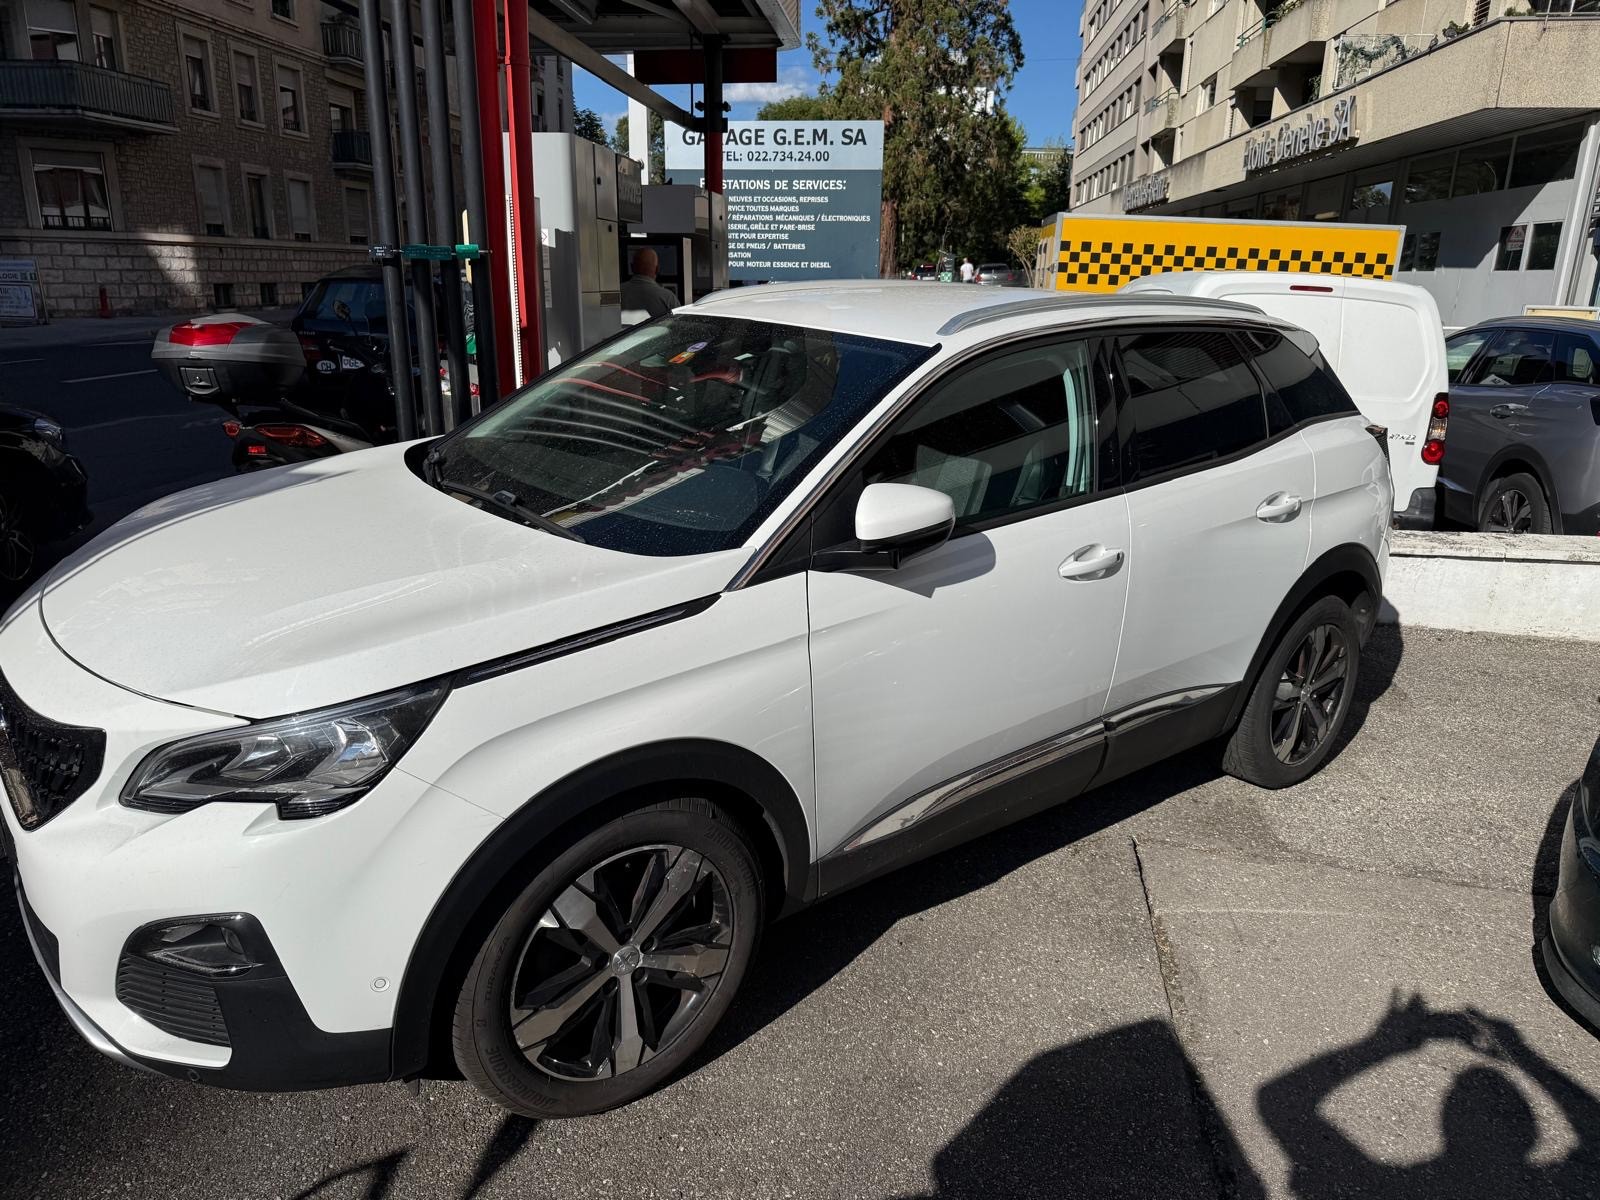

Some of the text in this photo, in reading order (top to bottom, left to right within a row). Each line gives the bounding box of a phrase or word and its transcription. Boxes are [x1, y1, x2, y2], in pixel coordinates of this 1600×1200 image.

[1330, 95, 1357, 144] SA
[682, 128, 867, 146] GAAGE G.E.M. SA
[747, 151, 830, 162] 022.734.24.00
[775, 180, 788, 190] DE
[793, 180, 847, 190] SERVICES:
[762, 196, 799, 204] OCCASIONS,
[732, 213, 773, 221] RÉPARATIONS
[775, 213, 815, 222] MÉCANIQUES
[821, 213, 871, 222] ÉLECTRONIQUES
[750, 222, 769, 230] GRÊLE
